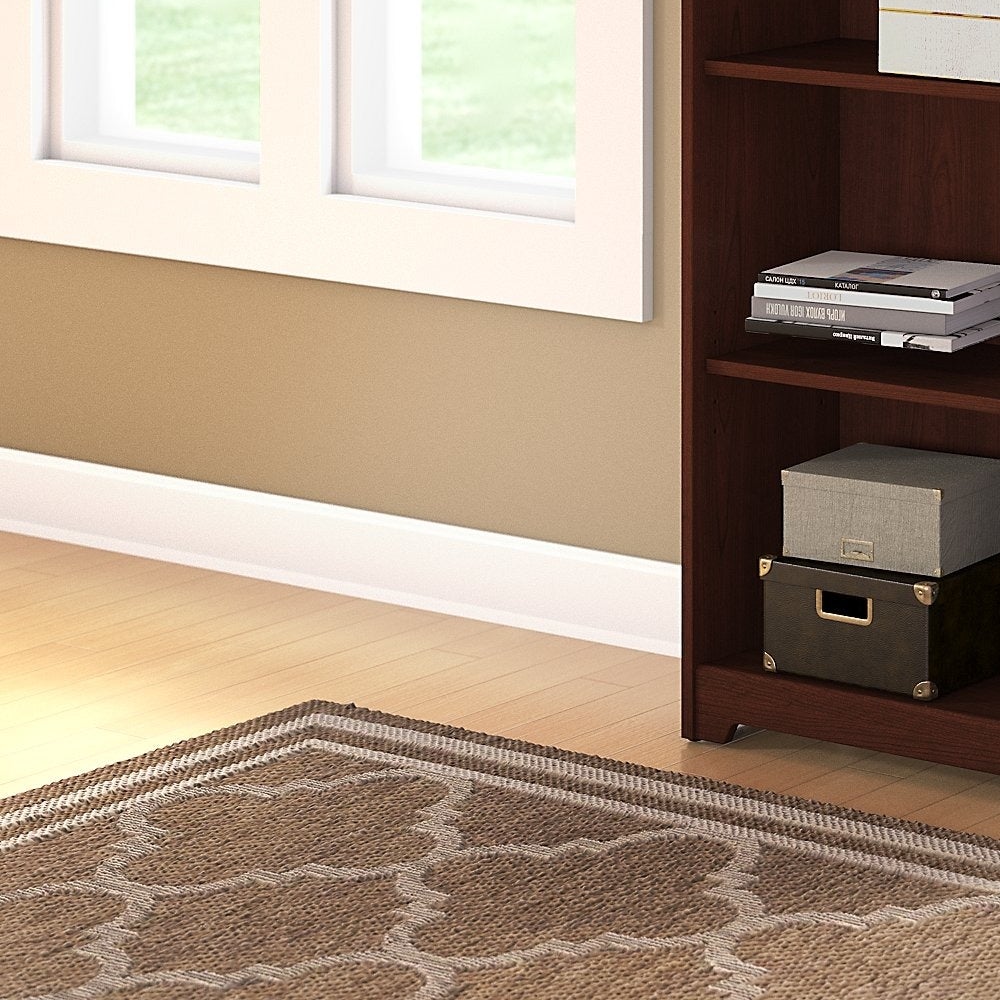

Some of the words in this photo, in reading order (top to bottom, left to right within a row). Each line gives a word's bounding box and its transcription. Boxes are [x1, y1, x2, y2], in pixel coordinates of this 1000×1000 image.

[807, 291, 842, 302] LORIOT
[790, 305, 804, 317] IGOR
[806, 306, 825, 319] ВУЛОХ
[827, 309, 846, 322] ИГОРЬ
